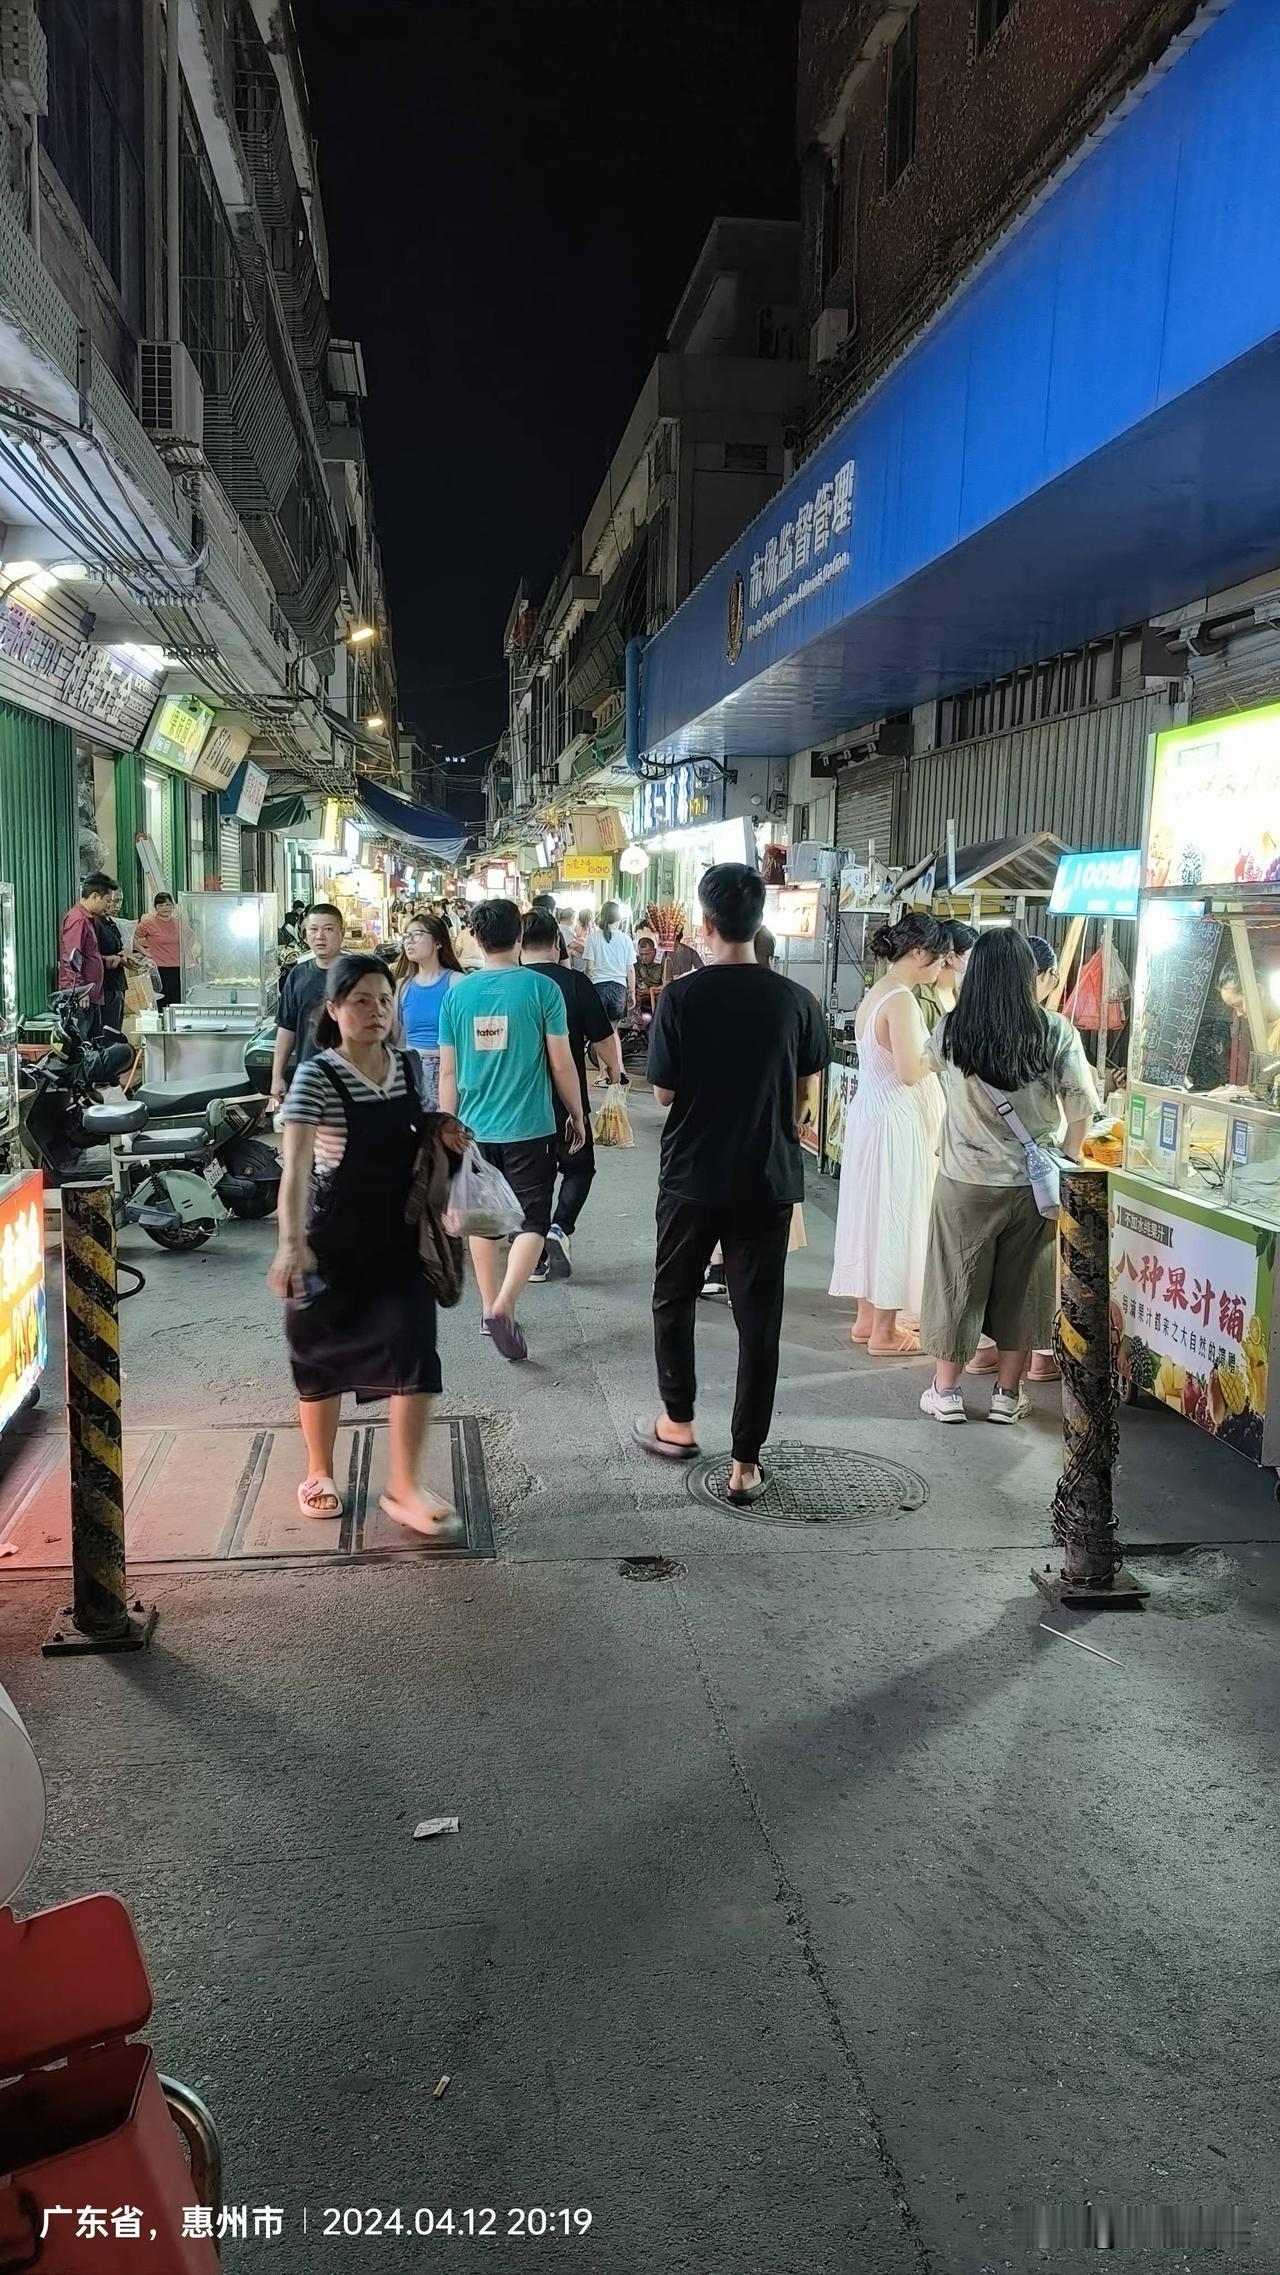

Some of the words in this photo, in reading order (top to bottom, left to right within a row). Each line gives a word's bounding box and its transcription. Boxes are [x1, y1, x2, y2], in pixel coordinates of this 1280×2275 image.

[749, 459, 855, 610] 市场监督管理
[1123, 1211, 1166, 1243] 不加水纯果汁
[1116, 1250, 1248, 1343] 八种果汁铺
